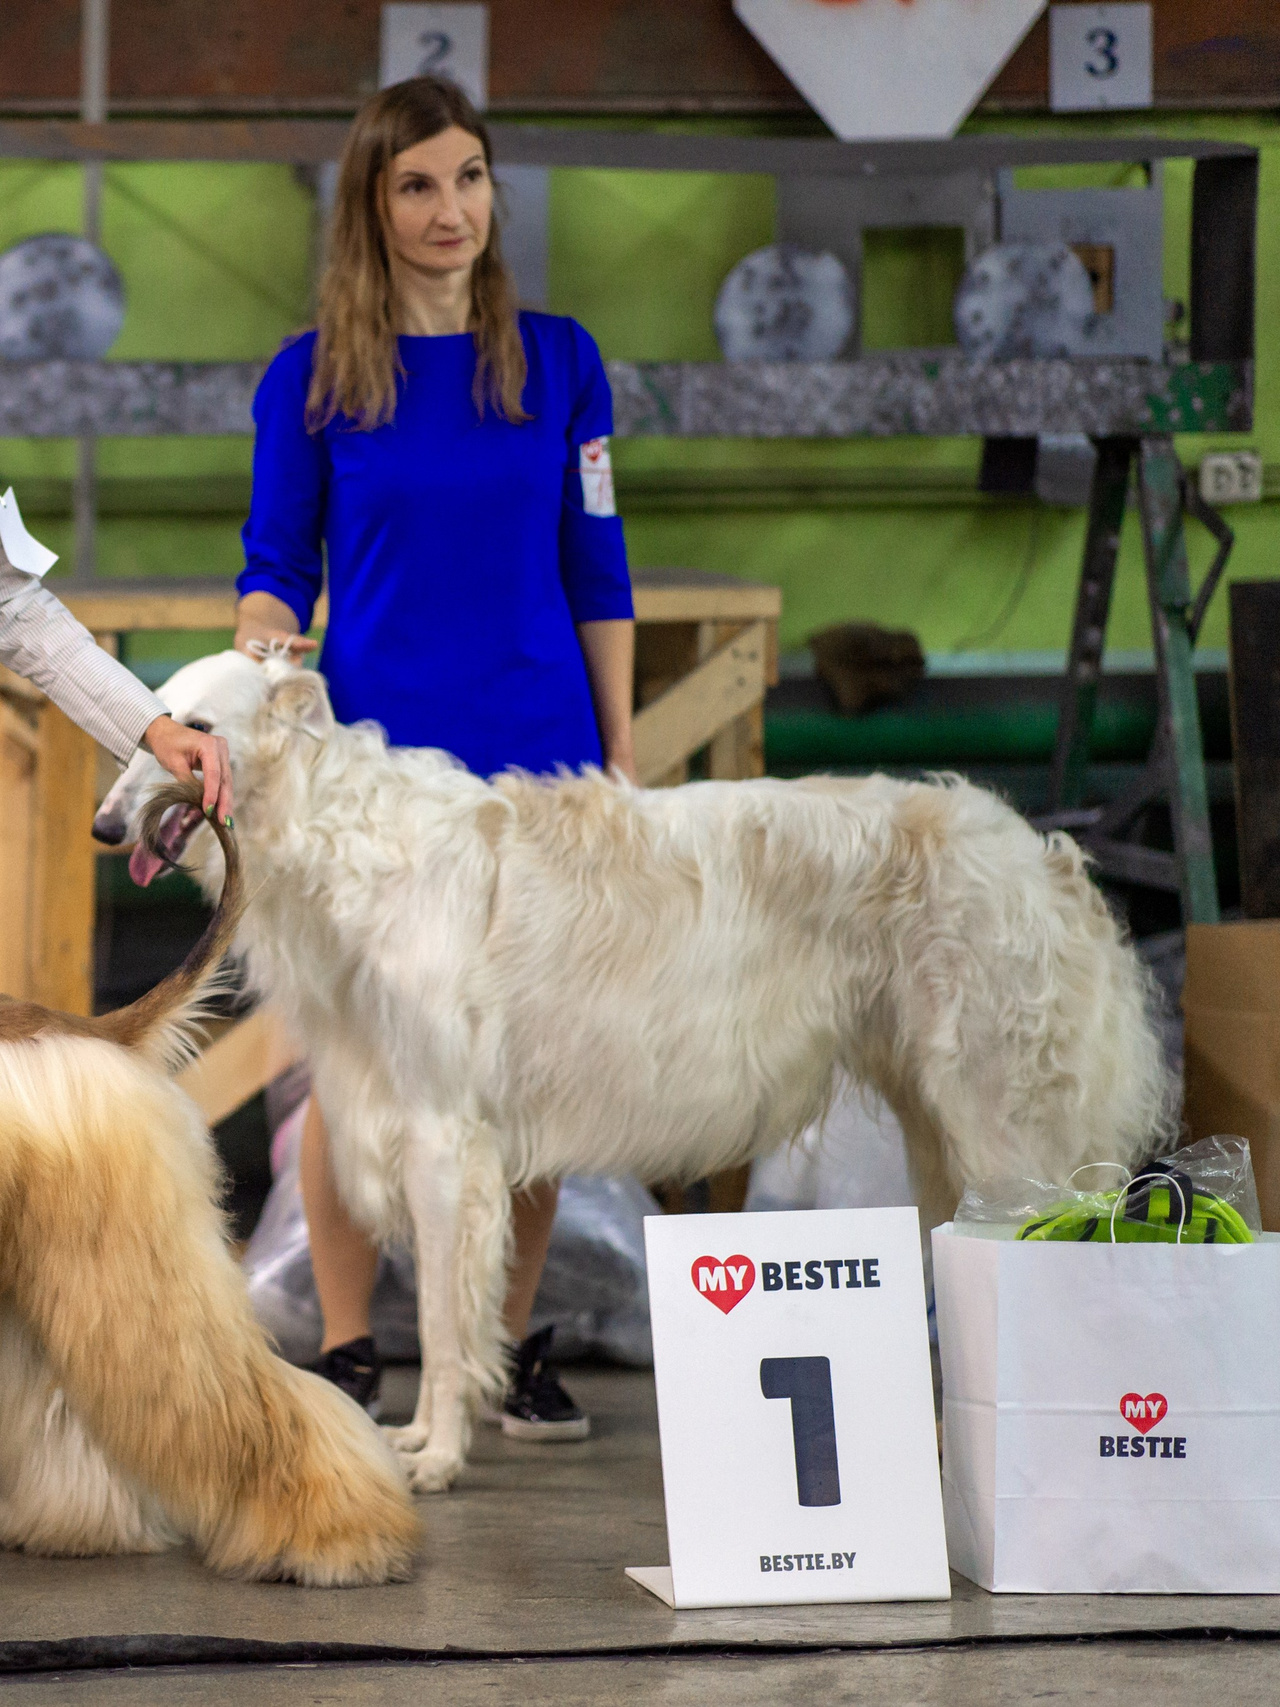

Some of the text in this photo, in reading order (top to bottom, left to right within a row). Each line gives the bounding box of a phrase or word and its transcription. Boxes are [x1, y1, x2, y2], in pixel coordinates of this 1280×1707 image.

[418, 30, 453, 79] 2
[1084, 27, 1119, 80] 3
[698, 1258, 881, 1292] MY BESTIE
[1124, 1400, 1163, 1418] MY
[759, 1355, 842, 1507] 1
[1099, 1435, 1187, 1458] BESTIE
[760, 1552, 857, 1572] BESTIE.BY
